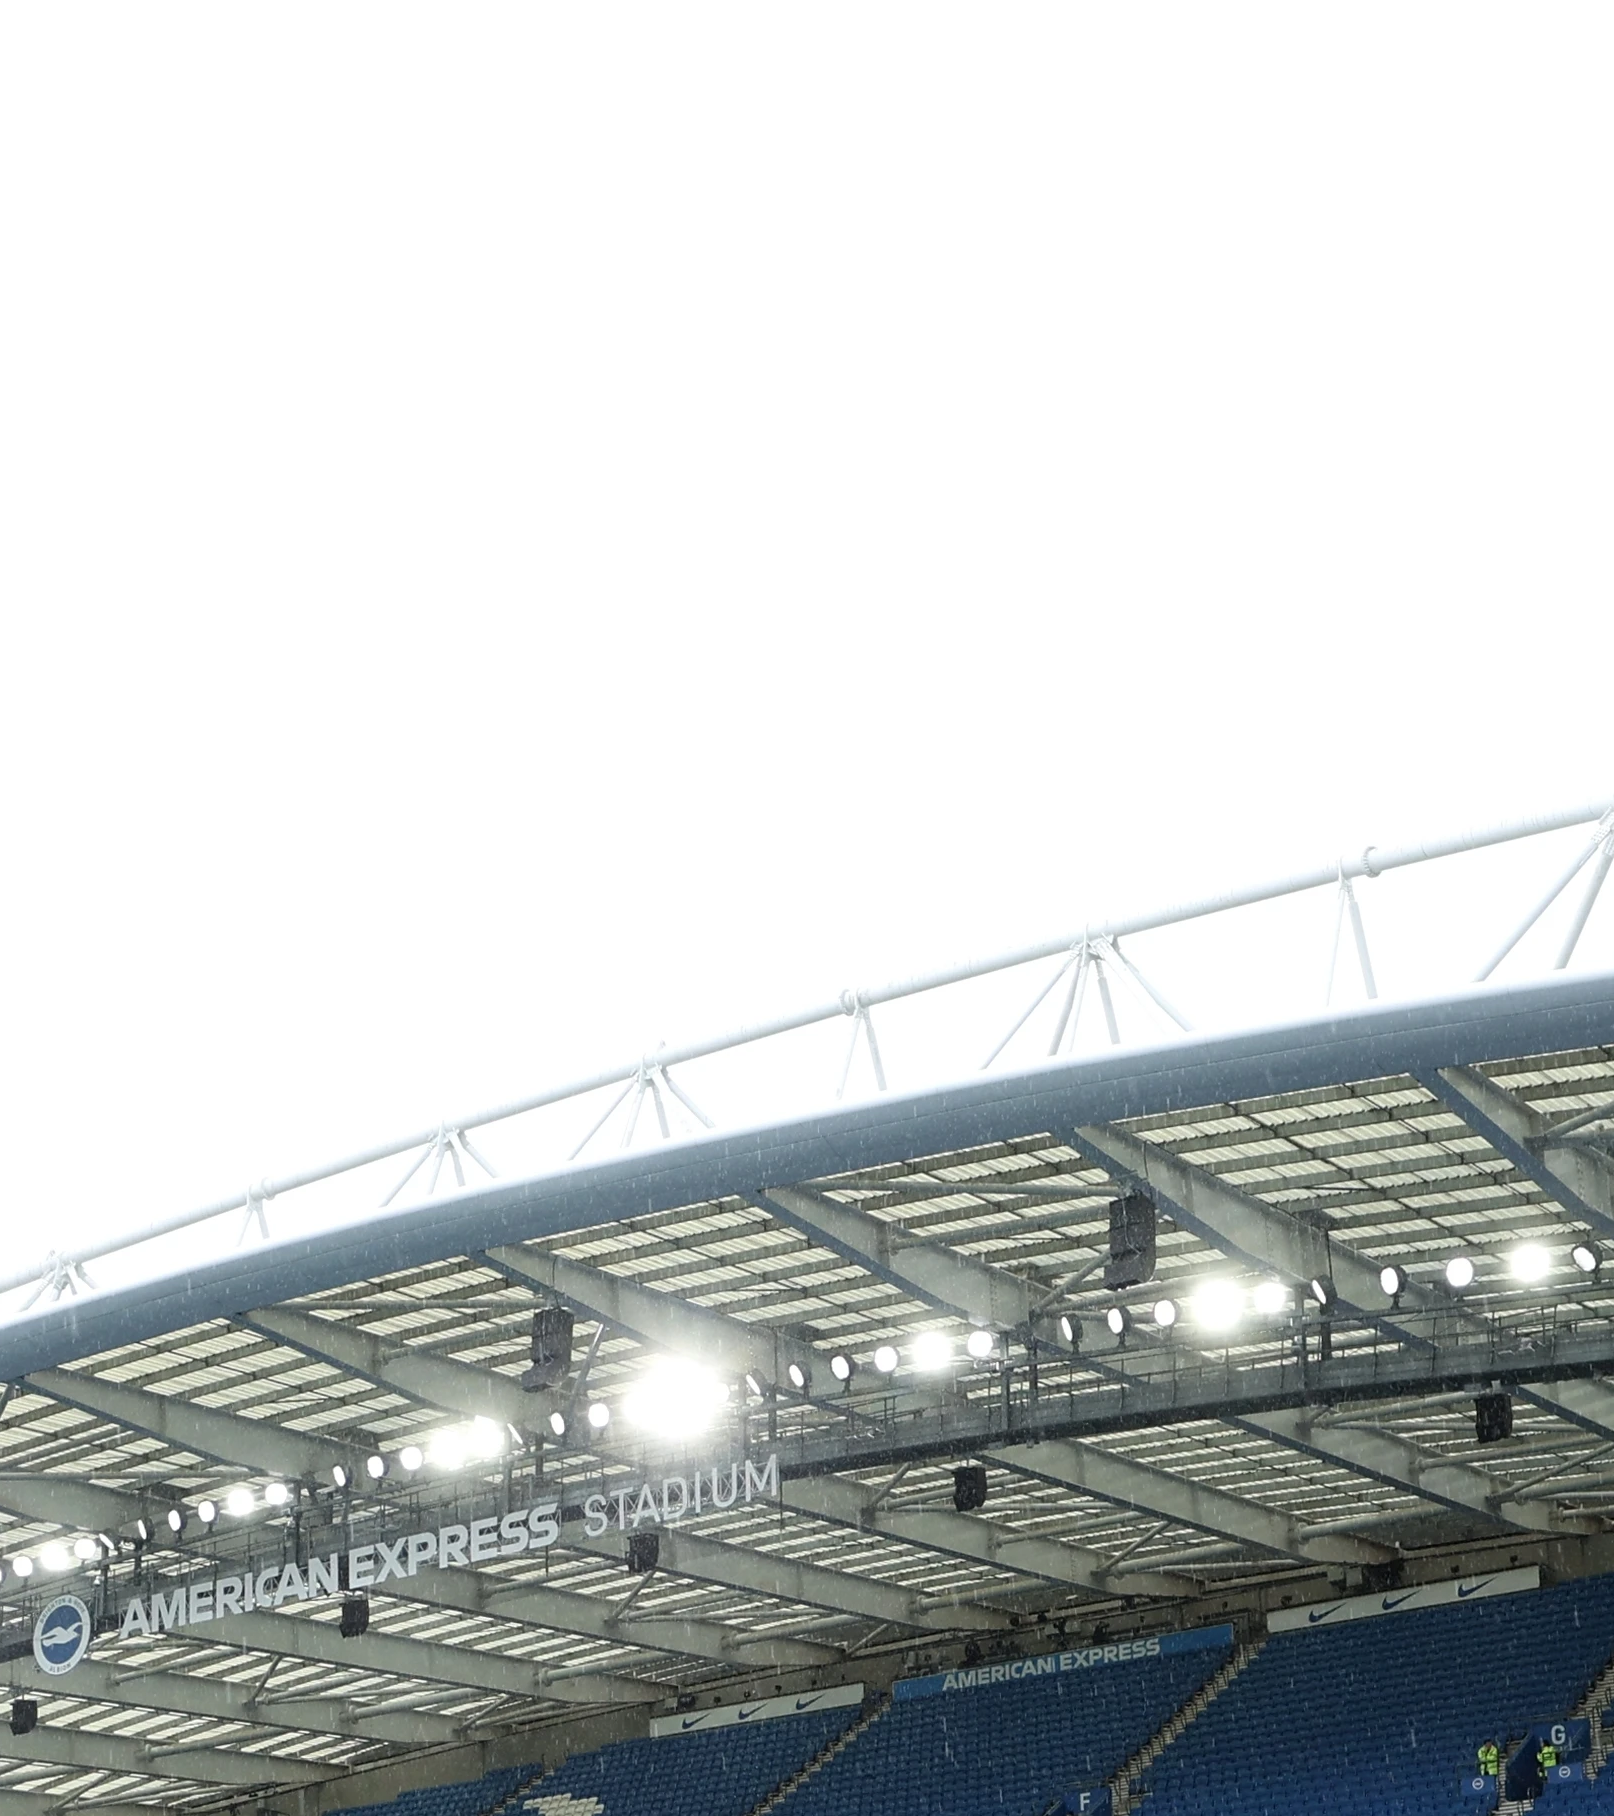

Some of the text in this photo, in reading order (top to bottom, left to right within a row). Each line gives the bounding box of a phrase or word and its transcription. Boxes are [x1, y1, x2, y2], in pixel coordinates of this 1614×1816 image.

[118, 1453, 779, 1641] AMERICAN EXPRESS STADIUM
[942, 1637, 1161, 1692] AMERICAN EXPRESS
[1551, 1725, 1566, 1745] G
[1079, 1792, 1091, 1811] F
